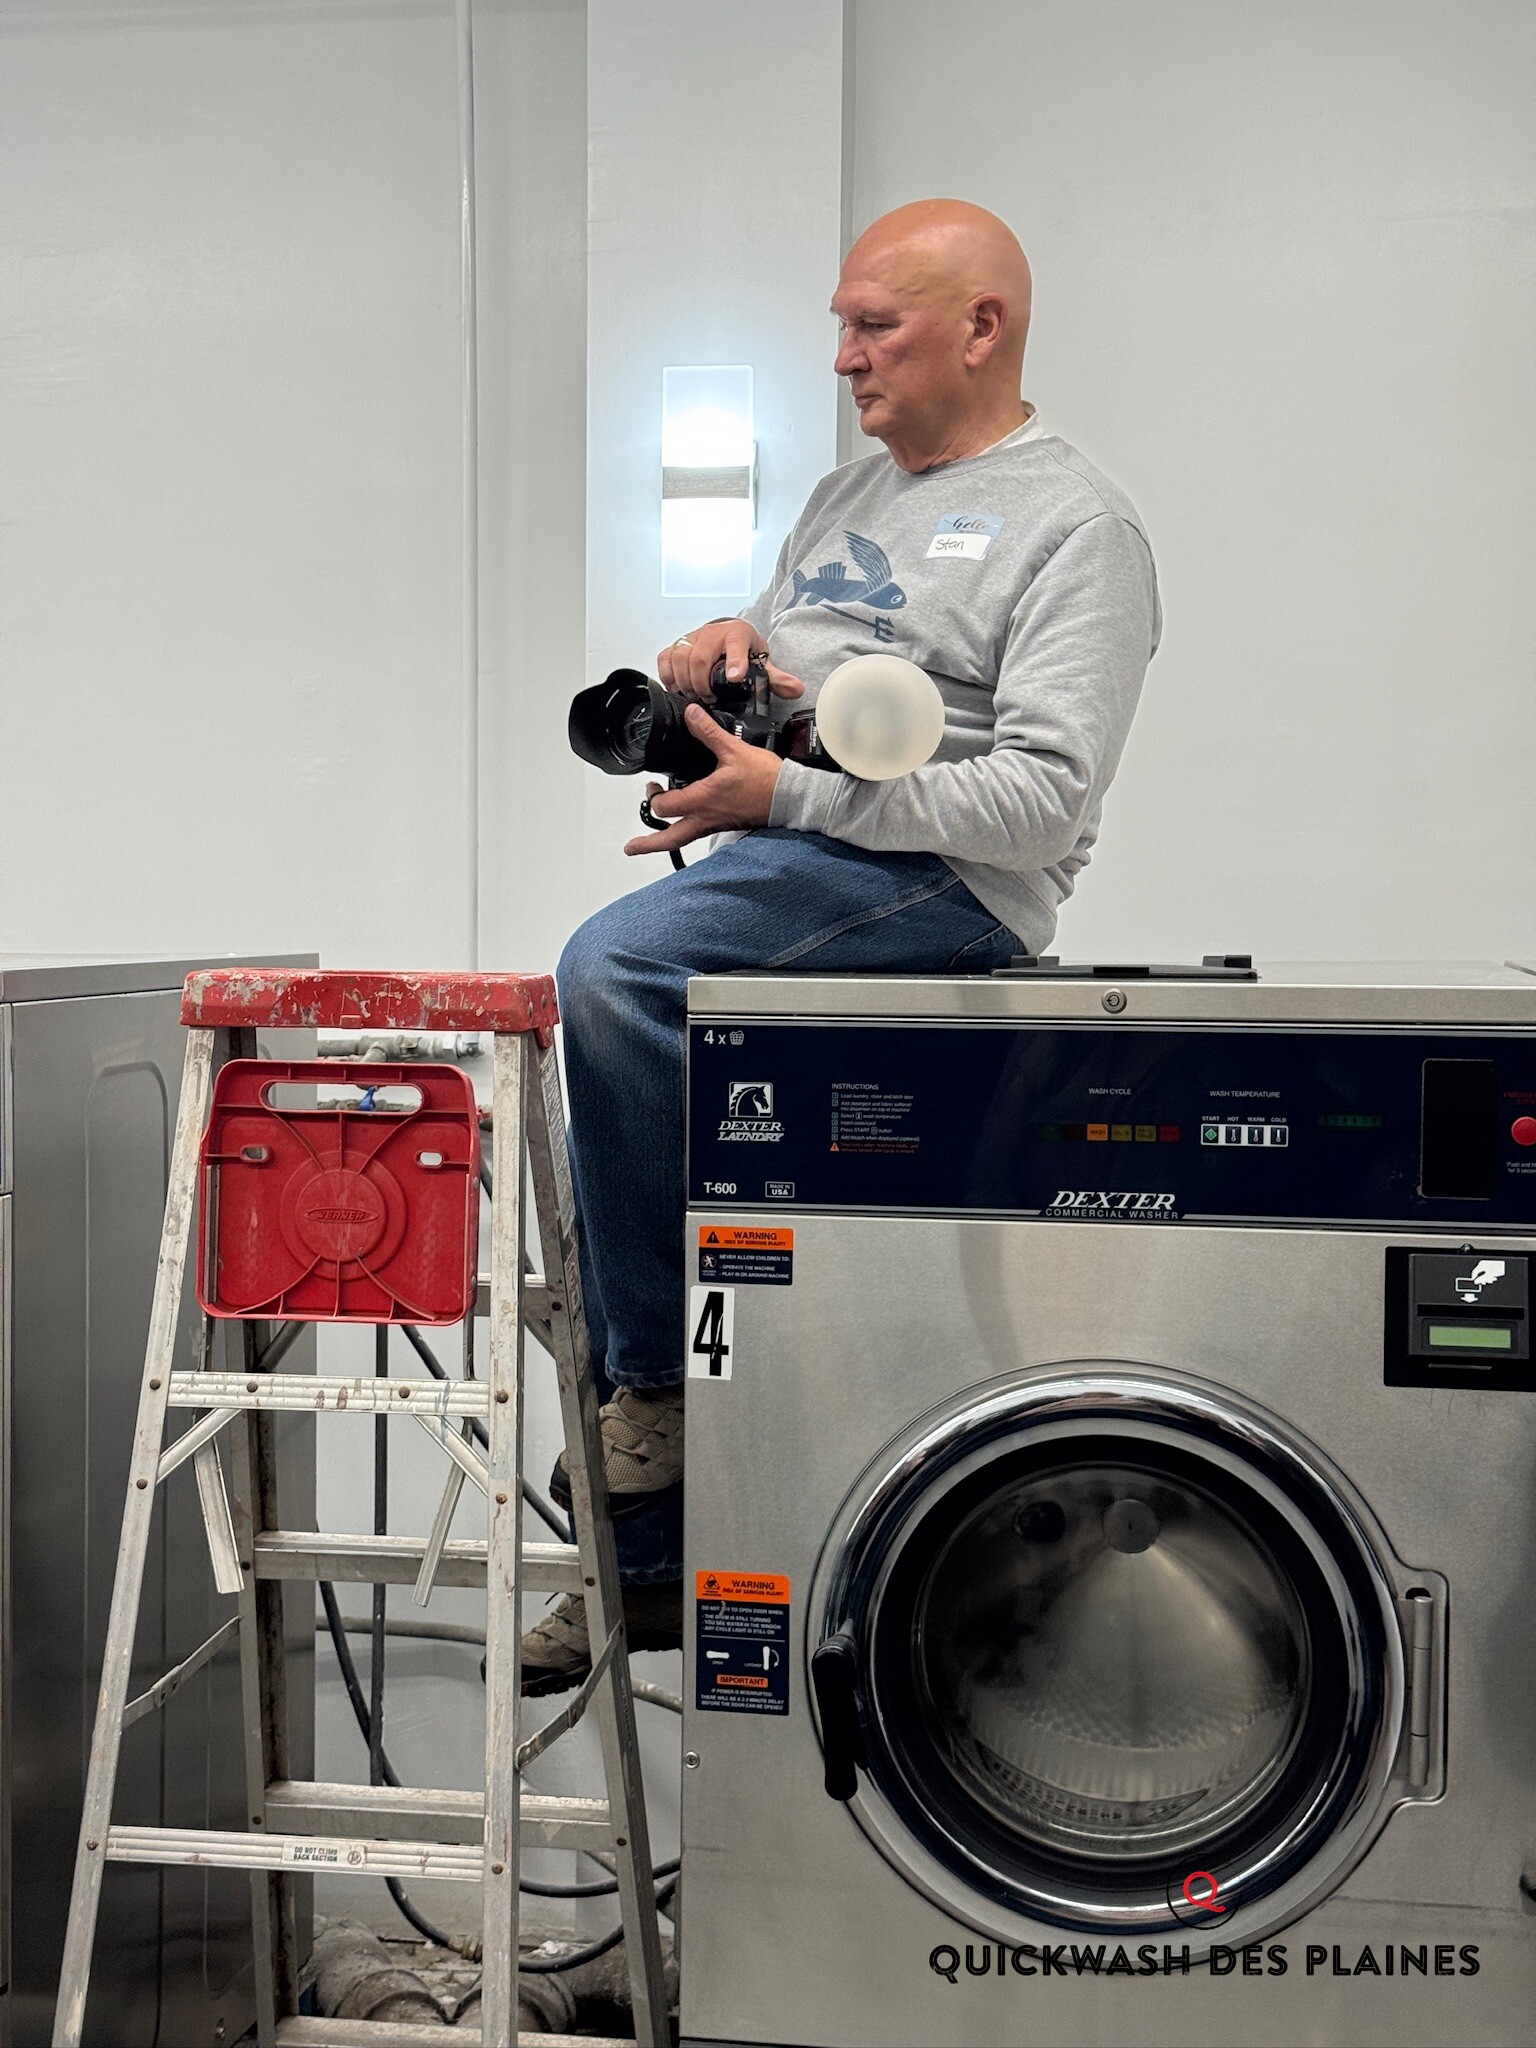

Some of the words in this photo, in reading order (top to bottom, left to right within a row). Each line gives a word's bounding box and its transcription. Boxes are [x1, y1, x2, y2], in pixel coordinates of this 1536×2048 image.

[704, 1030, 714, 1045] 4
[718, 1120, 782, 1131] DEXTER
[717, 1132, 784, 1142] LAUNDRY
[703, 1182, 737, 1194] T-600
[1049, 1190, 1176, 1210] DEXTER
[316, 1210, 366, 1220] WERNER
[1045, 1208, 1123, 1218] COMMERCIAL
[1129, 1210, 1178, 1219] WASHER
[734, 1231, 777, 1240] WARNING
[693, 1291, 729, 1376] 4
[732, 1580, 775, 1590] WARNING
[720, 1676, 764, 1685] IMPORTANT
